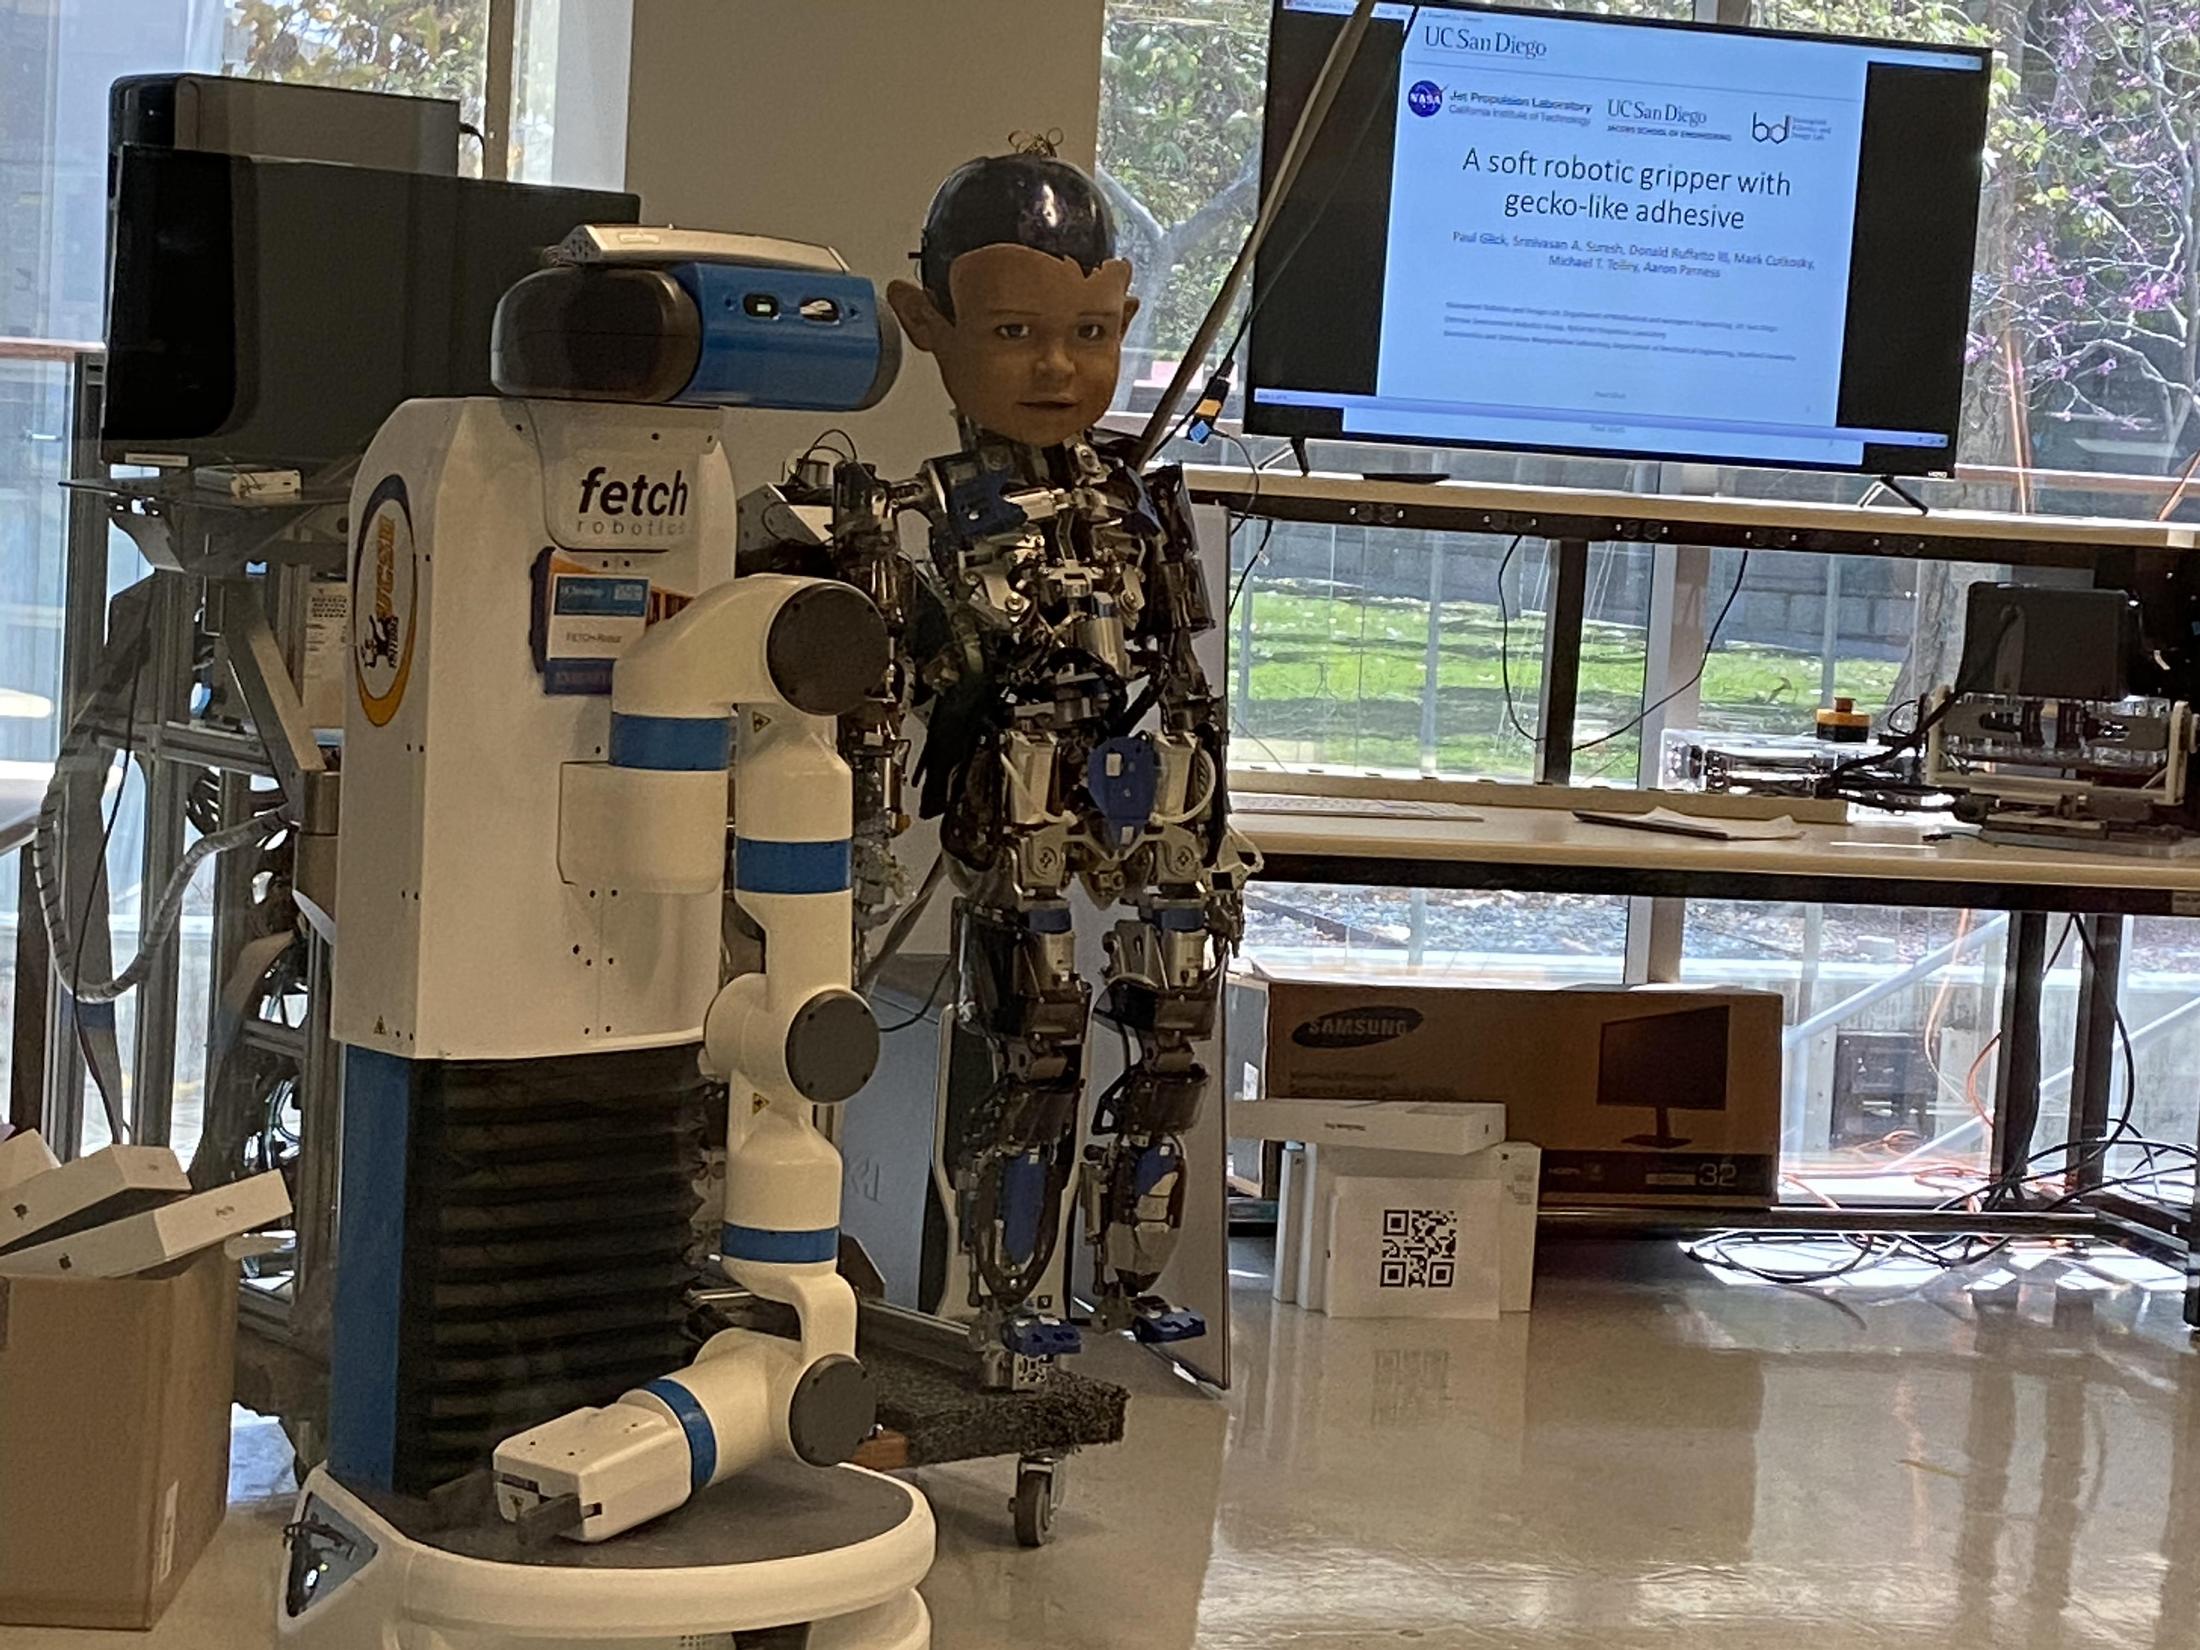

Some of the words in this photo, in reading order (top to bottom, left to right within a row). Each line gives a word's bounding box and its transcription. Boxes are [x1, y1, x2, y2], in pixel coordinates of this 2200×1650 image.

[1425, 25, 1453, 48] UC
[1456, 28, 1491, 52] San
[1495, 31, 1547, 60] Diego
[1450, 89, 1467, 102] Jet
[1470, 92, 1530, 107] Propulsion
[1532, 97, 1592, 114] Laboratory
[1607, 98, 1632, 118] UC
[1634, 100, 1662, 121] San
[1665, 103, 1707, 128] Diego
[1462, 147, 1480, 172] A
[1488, 150, 1537, 176] soft
[1543, 154, 1634, 185] robotic
[1640, 166, 1732, 194] gripper
[1737, 171, 1791, 197] with
[1504, 190, 1629, 221] gecko-like
[1636, 200, 1745, 230] adhesive
[578, 466, 689, 517] fetch
[576, 519, 688, 537] robotics
[1308, 1017, 1407, 1036] SAMSUNG
[1699, 1162, 1738, 1187] 32
